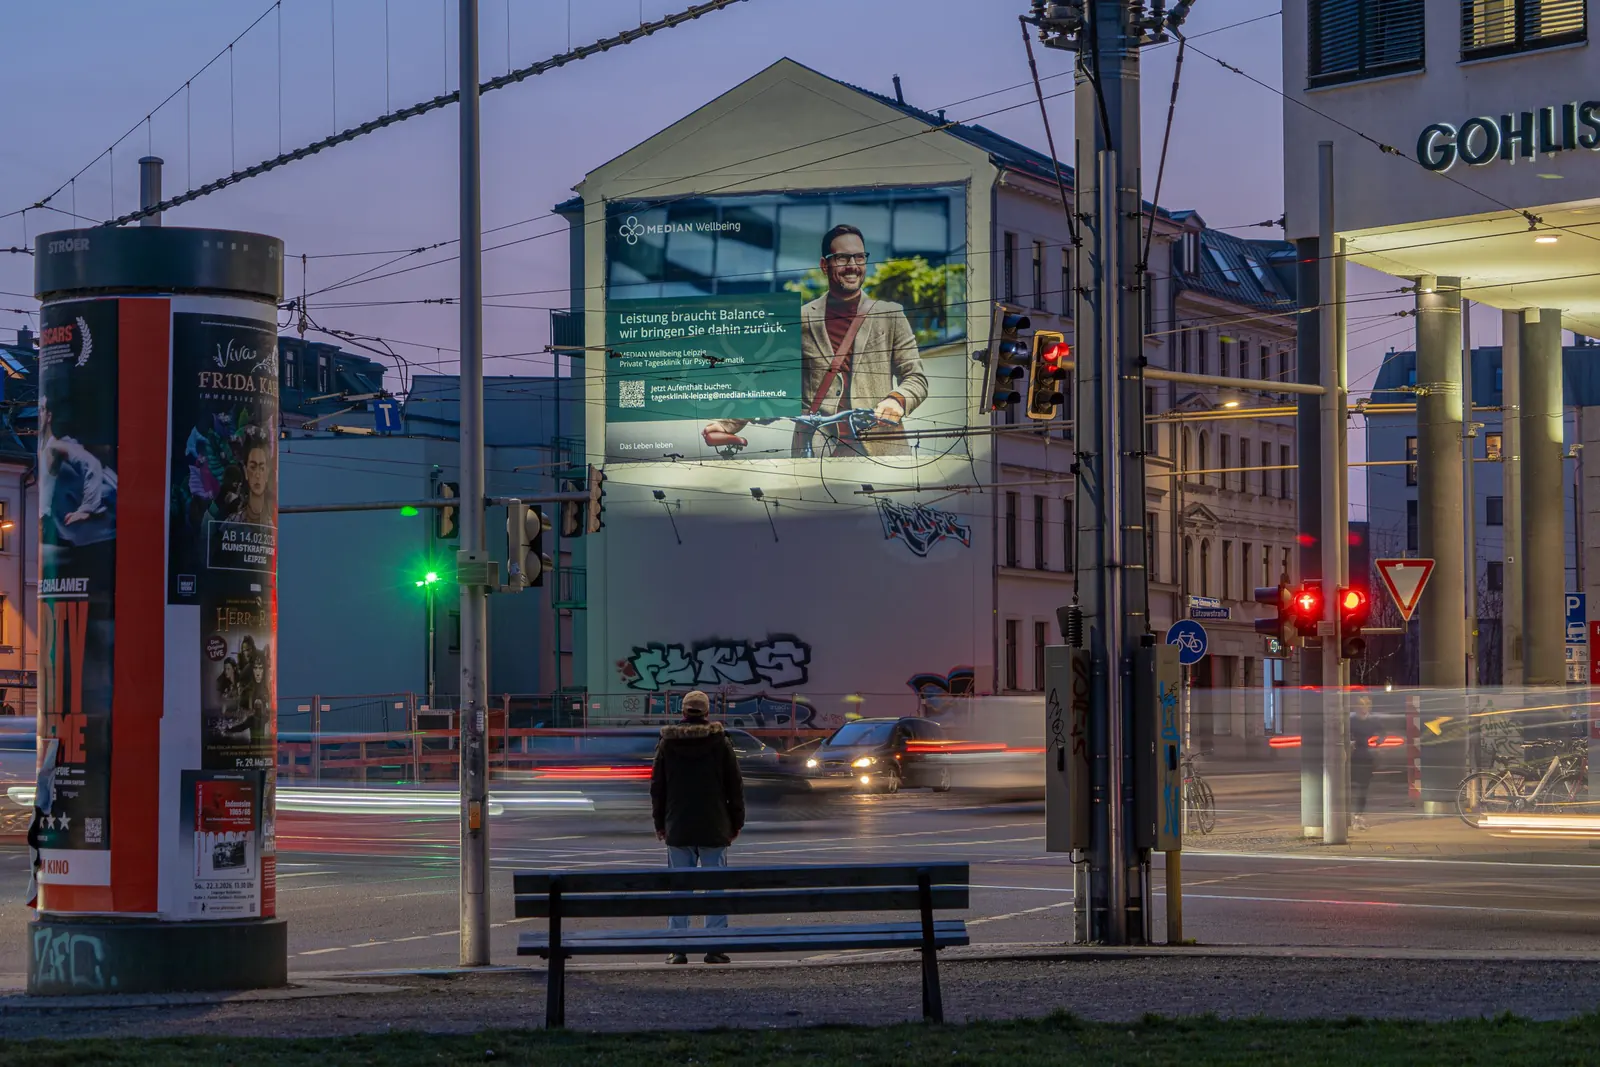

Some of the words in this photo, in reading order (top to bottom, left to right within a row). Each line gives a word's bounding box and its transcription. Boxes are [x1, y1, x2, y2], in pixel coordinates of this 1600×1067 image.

[1417, 101, 1600, 173] GOHLIS
[647, 222, 693, 235] MEDIAN
[696, 220, 741, 233] Wellbeing
[619, 312, 669, 326] Leistung
[671, 310, 717, 323] braucht
[719, 309, 765, 321] Balance
[619, 328, 638, 339] wir
[640, 325, 686, 339] bringen
[688, 325, 706, 337] Sie
[708, 324, 741, 336] dahin
[743, 322, 787, 335] zurück.
[216, 338, 257, 368] Viva
[619, 351, 648, 359] MEDIAN
[648, 350, 682, 359] Wellbeing
[619, 360, 643, 368] Private
[644, 358, 682, 369] Tagesklinik
[682, 358, 692, 366] für
[694, 356, 745, 366] Psycmatik
[198, 371, 256, 393] FRIDA
[651, 384, 667, 394] Jetzt
[667, 383, 703, 392] Aufenthalt
[704, 382, 732, 391] buchen:
[654, 441, 674, 449] leben
[221, 530, 238, 542] AB
[243, 555, 267, 565] LEIPZIG
[43, 577, 90, 592] CHALAMET
[1566, 596, 1581, 617] P
[209, 649, 225, 658] LIVE
[235, 758, 244, 767] Fr.
[48, 860, 69, 875] KINO
